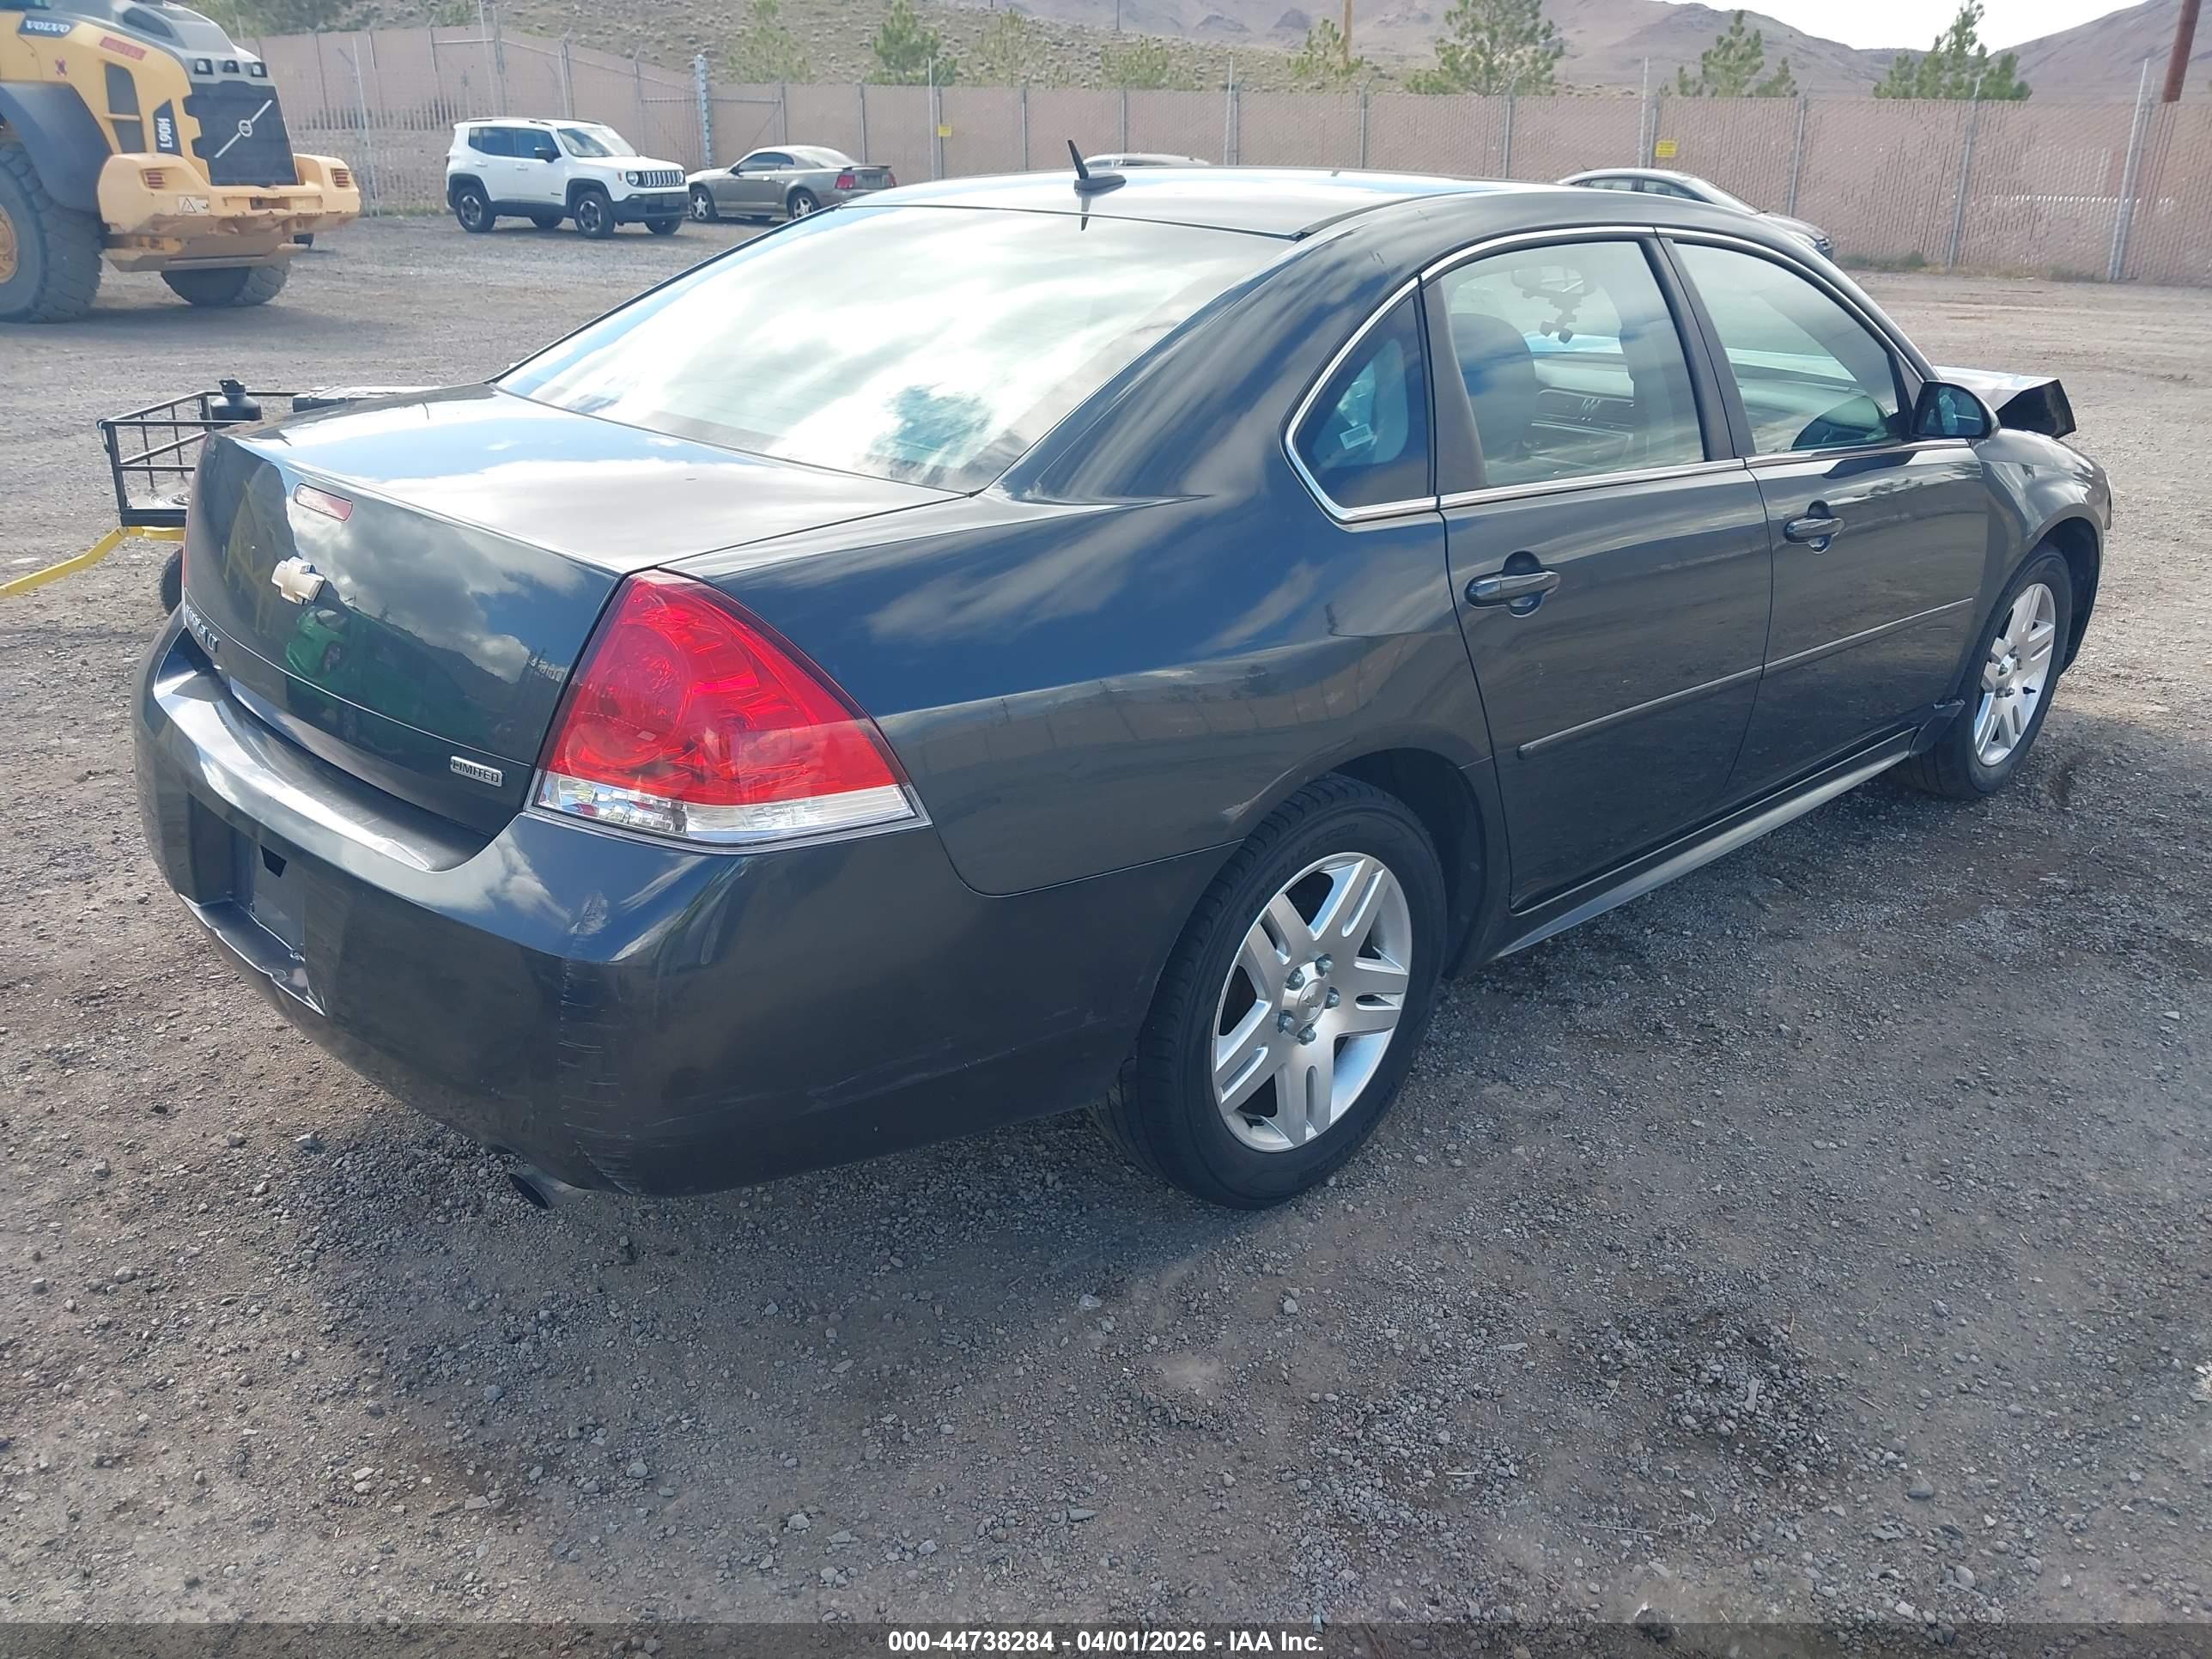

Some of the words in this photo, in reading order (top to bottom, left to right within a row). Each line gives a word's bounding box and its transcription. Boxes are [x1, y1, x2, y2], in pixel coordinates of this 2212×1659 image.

[26, 20, 70, 33] VOLVO
[157, 118, 173, 148] L90H
[453, 760, 499, 782] LIMITED
